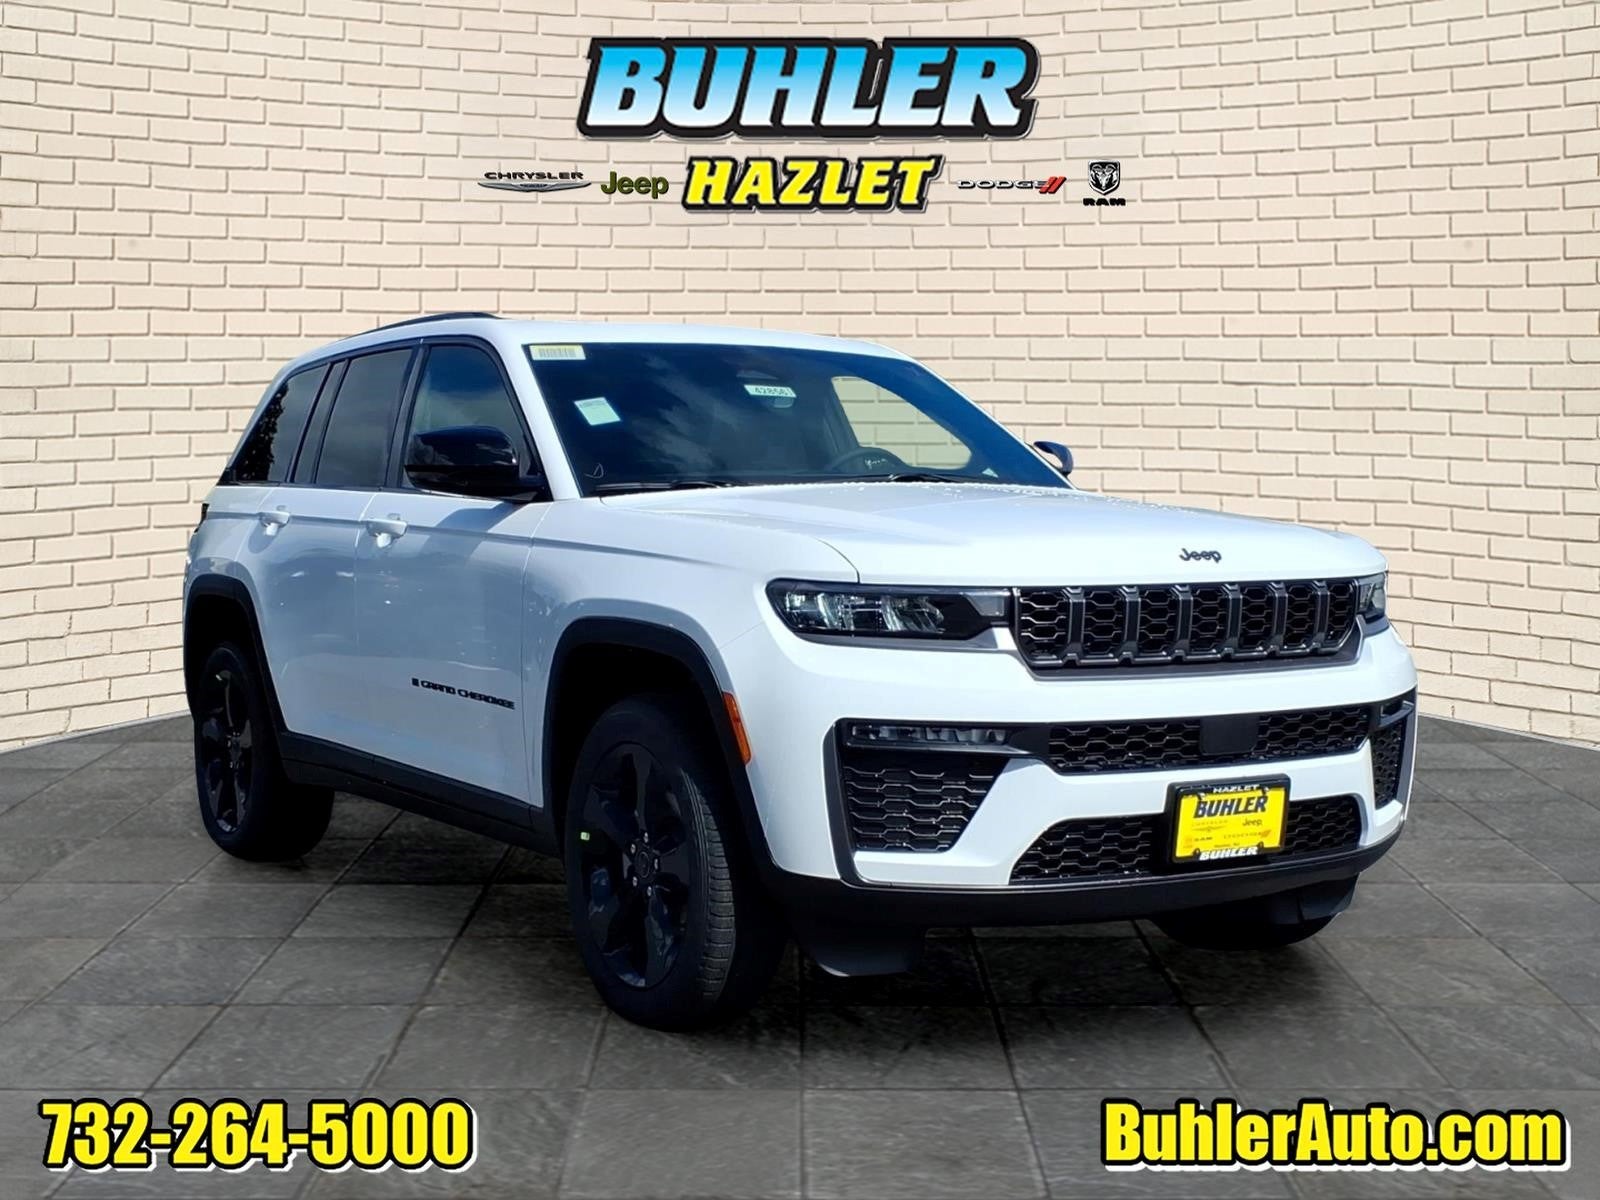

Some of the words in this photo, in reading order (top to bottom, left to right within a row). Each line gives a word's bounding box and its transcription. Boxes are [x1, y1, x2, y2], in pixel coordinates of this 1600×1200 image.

[1179, 547, 1222, 564] Jeep
[420, 680, 456, 695] GRAND
[457, 689, 515, 710] CHEROKEE
[1212, 784, 1260, 794] HAZLET
[1193, 795, 1268, 818] BUHLER
[1242, 818, 1264, 827] Jeep
[1199, 846, 1259, 861] BUHLER
